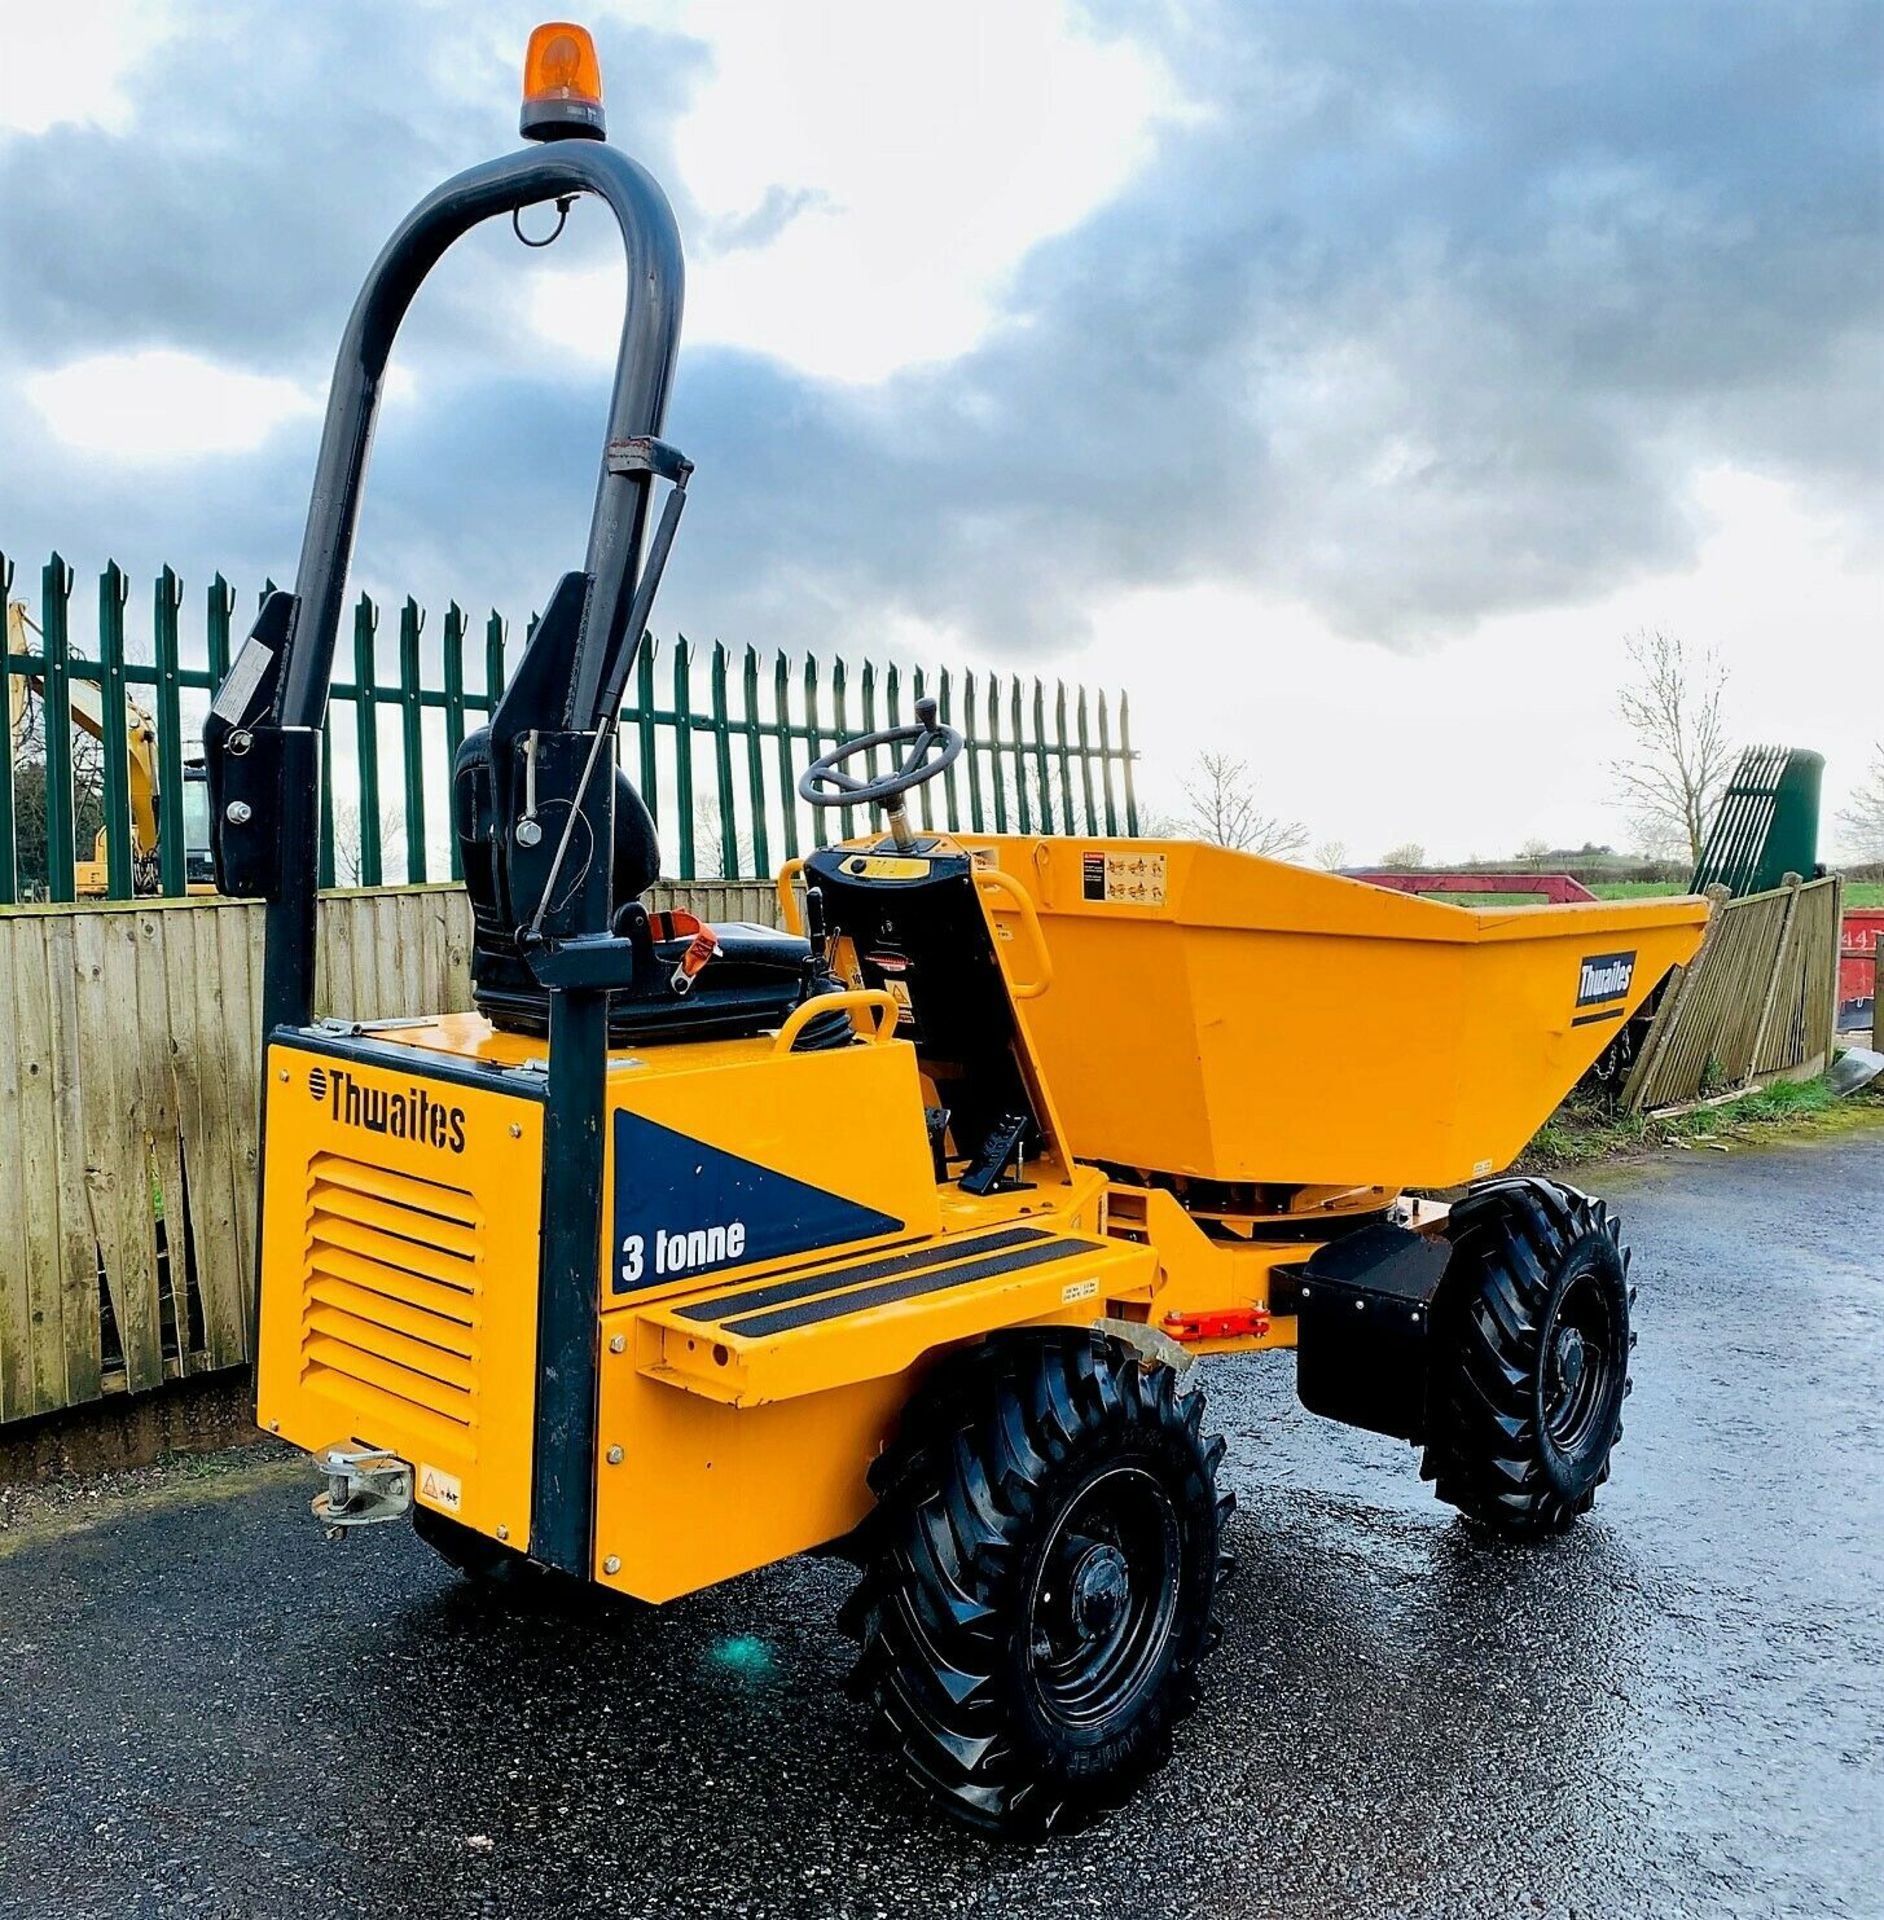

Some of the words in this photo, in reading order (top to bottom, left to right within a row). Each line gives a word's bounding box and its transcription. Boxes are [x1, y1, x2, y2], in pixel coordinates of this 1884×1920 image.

[1580, 960, 1632, 998] Thwaites
[328, 1069, 465, 1154] Thwaites
[622, 1234, 645, 1282] 3
[655, 1222, 746, 1274] tonne
